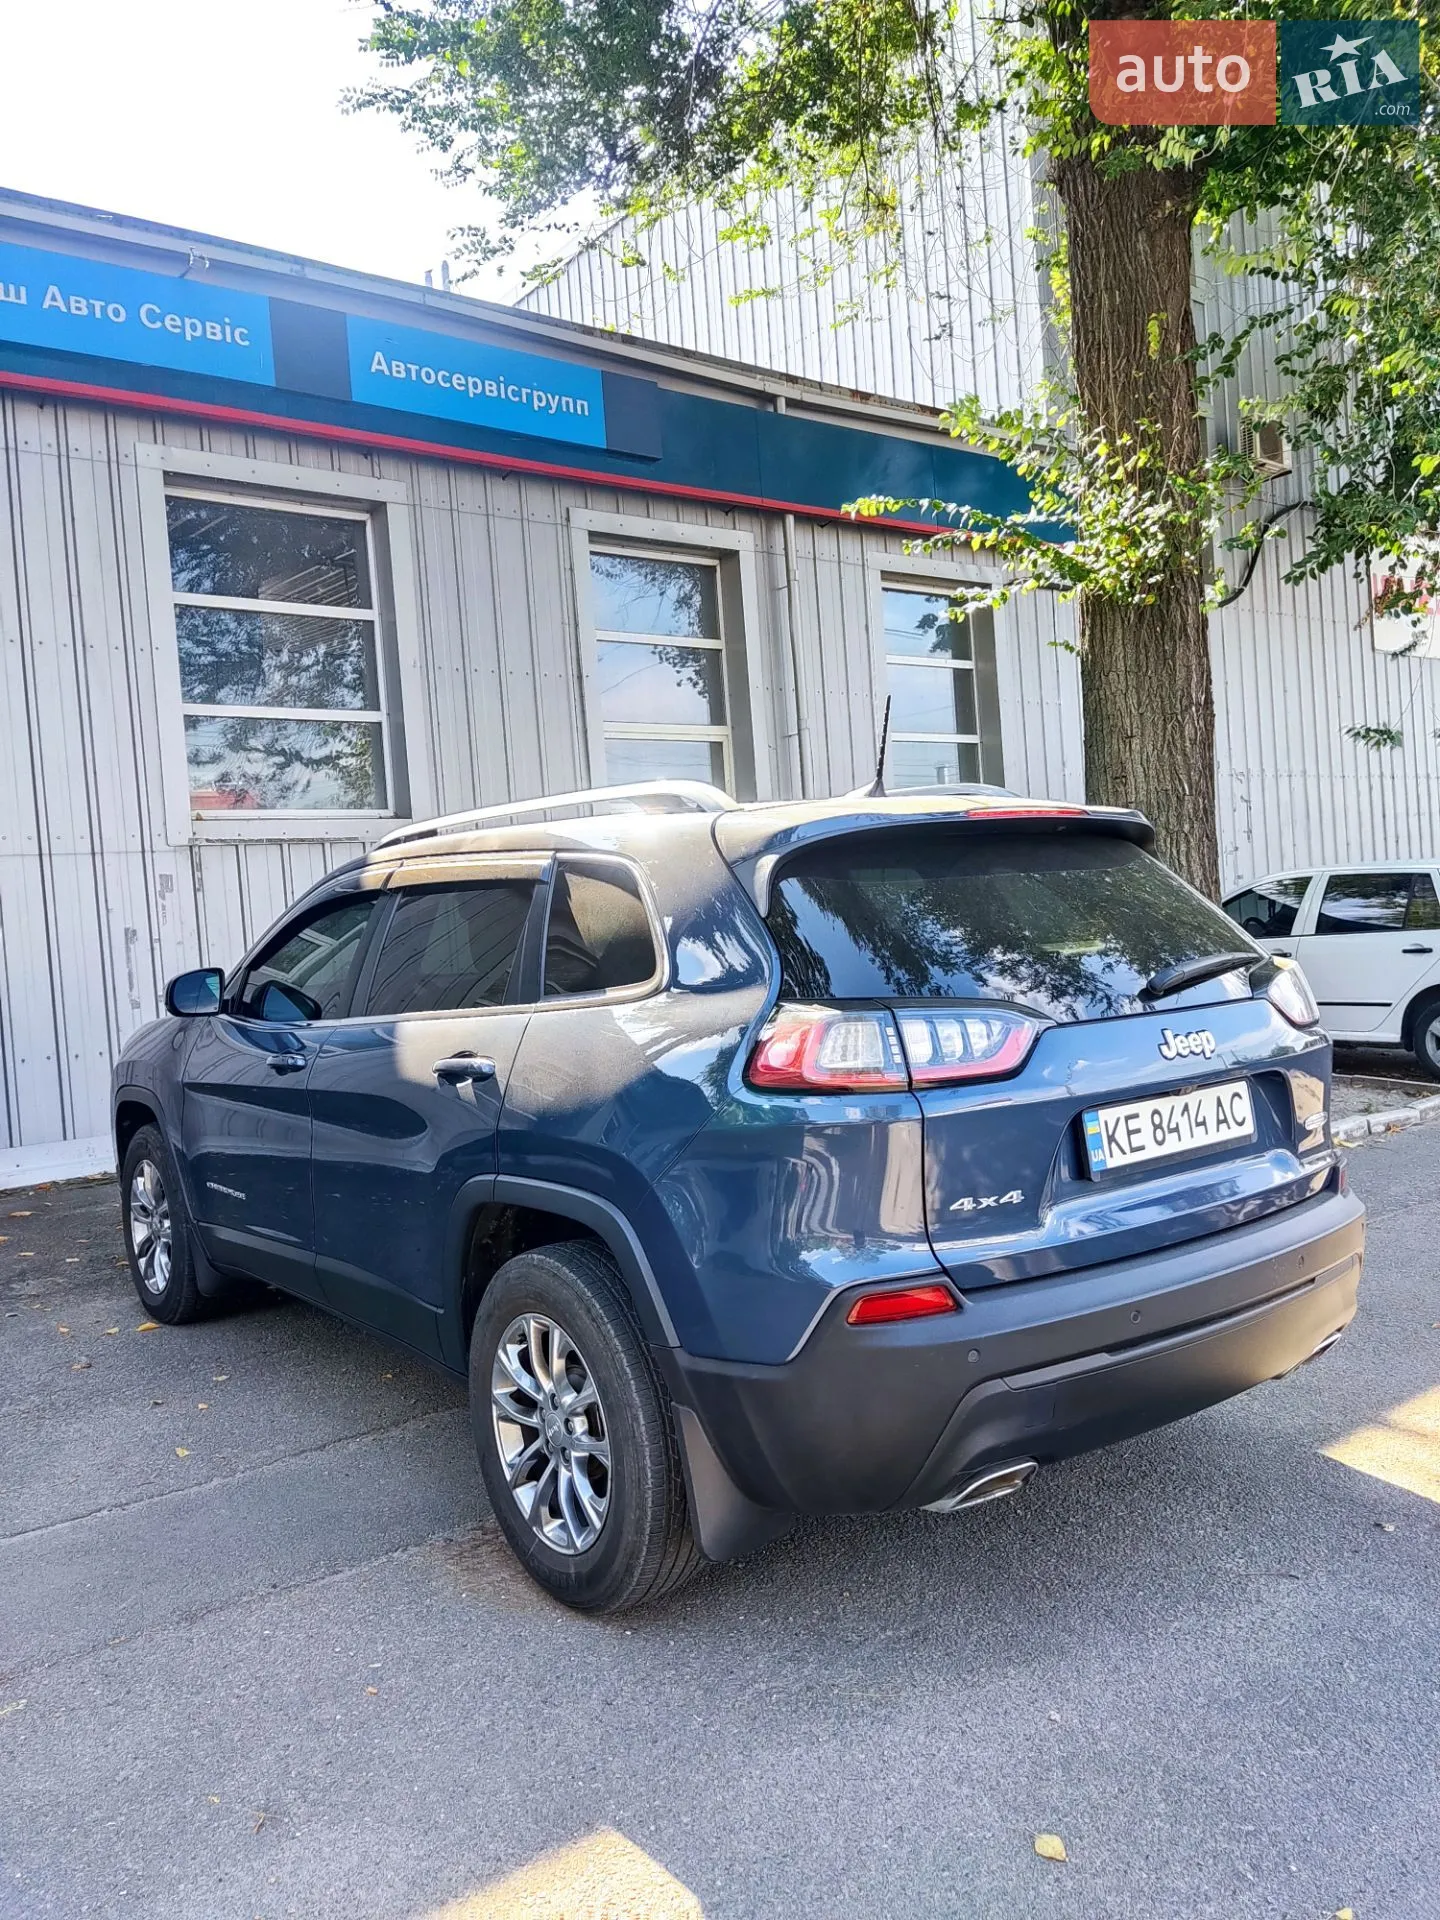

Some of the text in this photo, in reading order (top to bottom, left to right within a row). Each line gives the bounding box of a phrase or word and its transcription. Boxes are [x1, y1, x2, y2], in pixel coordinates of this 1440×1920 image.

[42, 284, 127, 323] Авто
[139, 303, 251, 347] Сервіс
[369, 350, 590, 417] Автосервісгрупп
[1158, 1028, 1216, 1061] Jeep
[1150, 1100, 1207, 1147] 8414
[1090, 1151, 1105, 1164] UA
